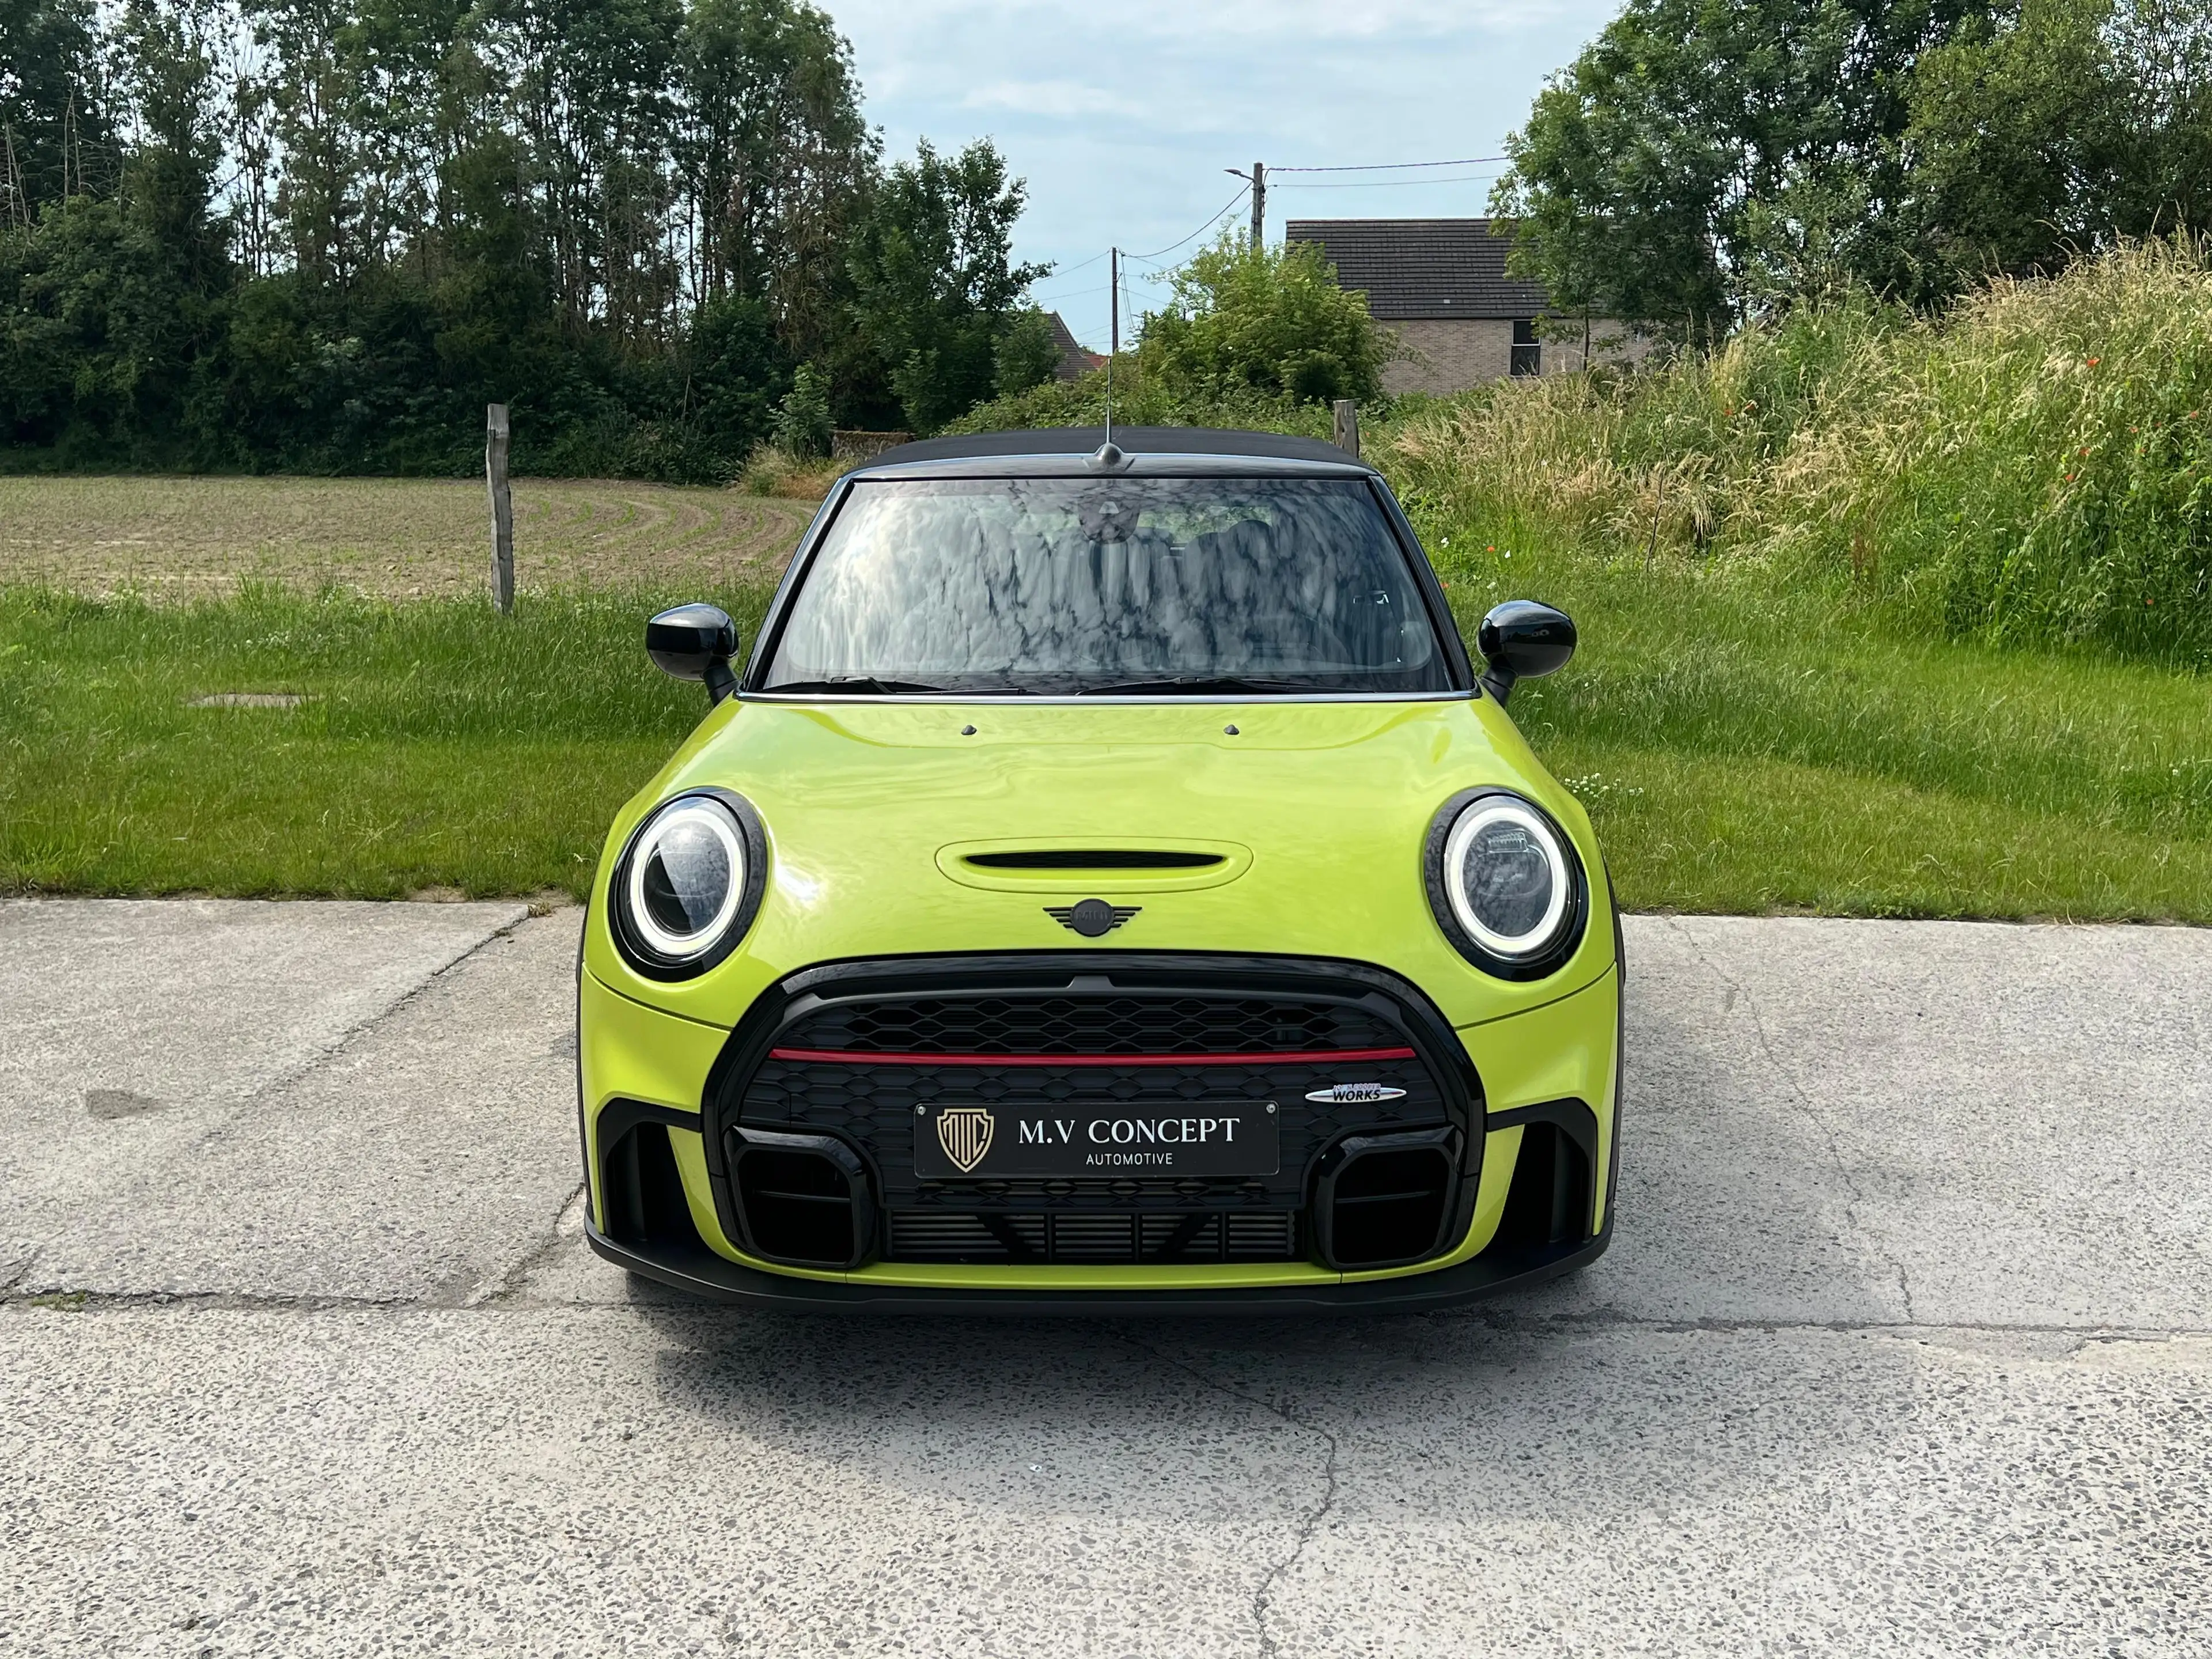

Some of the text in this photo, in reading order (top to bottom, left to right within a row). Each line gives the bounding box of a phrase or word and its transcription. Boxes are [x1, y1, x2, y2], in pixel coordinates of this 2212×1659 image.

[1333, 1089, 1381, 1101] WORKS
[1018, 1118, 1240, 1144] M.V CONCEPT
[1086, 1153, 1173, 1165] AUTOMOTIVE
